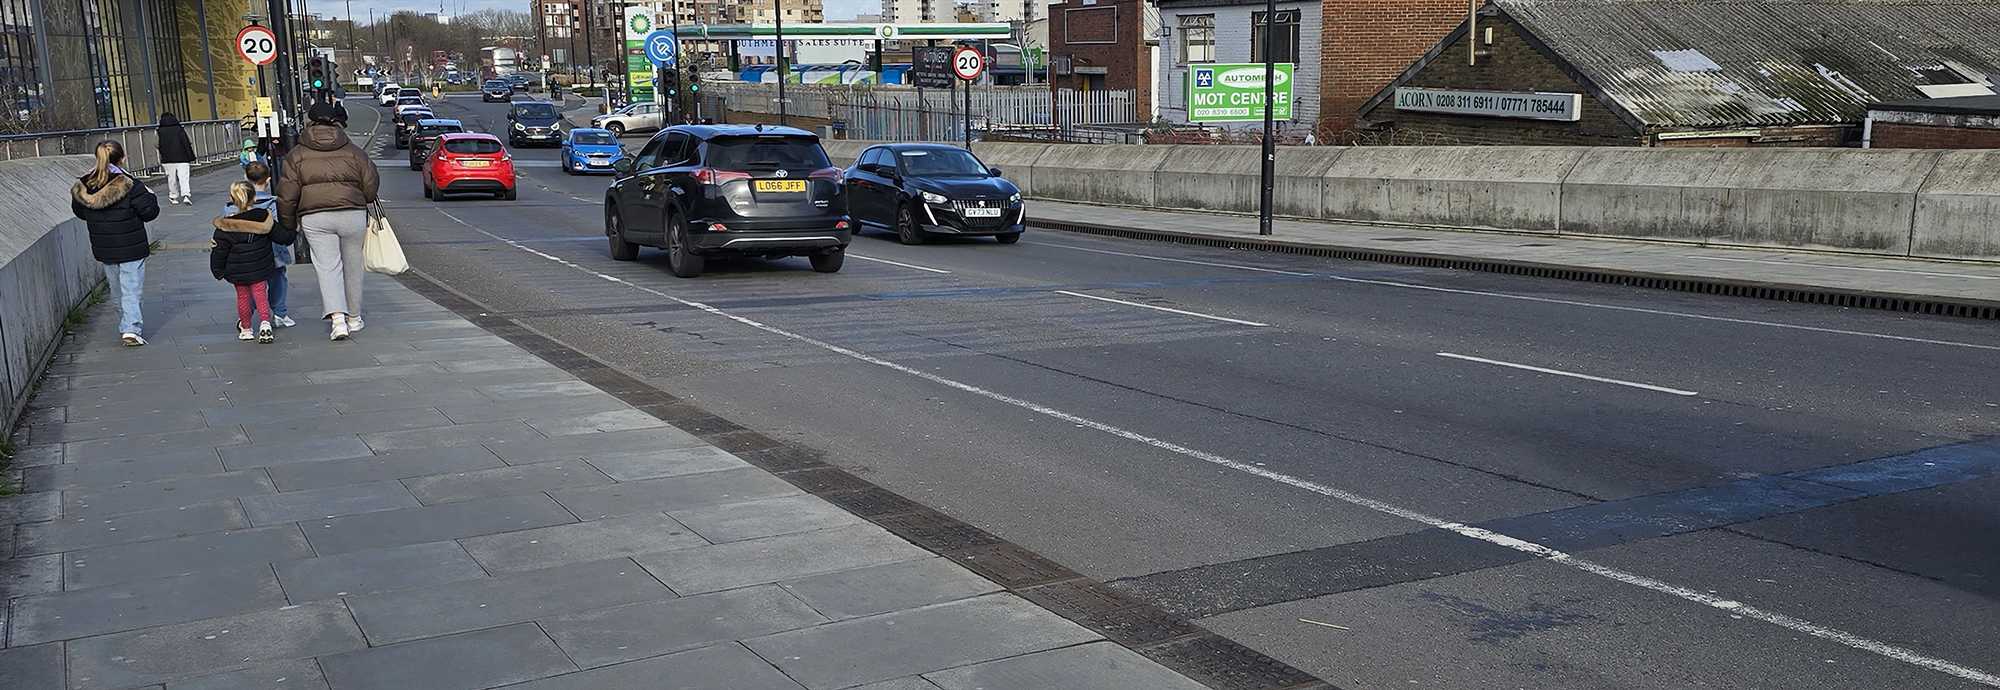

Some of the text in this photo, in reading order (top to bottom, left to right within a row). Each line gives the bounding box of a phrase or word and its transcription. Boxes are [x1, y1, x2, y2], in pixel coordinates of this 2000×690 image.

[244, 38, 273, 54] 20
[959, 56, 979, 70] 20
[1194, 93, 1226, 105] MOT
[1398, 92, 1433, 108] ACORN
[1436, 94, 1456, 108] 0208
[1457, 95, 1471, 108] 311
[1473, 96, 1493, 110] 6911
[1501, 97, 1528, 112] 07771
[1531, 99, 1566, 114] 785444
[759, 181, 801, 190] LO66 JFF
